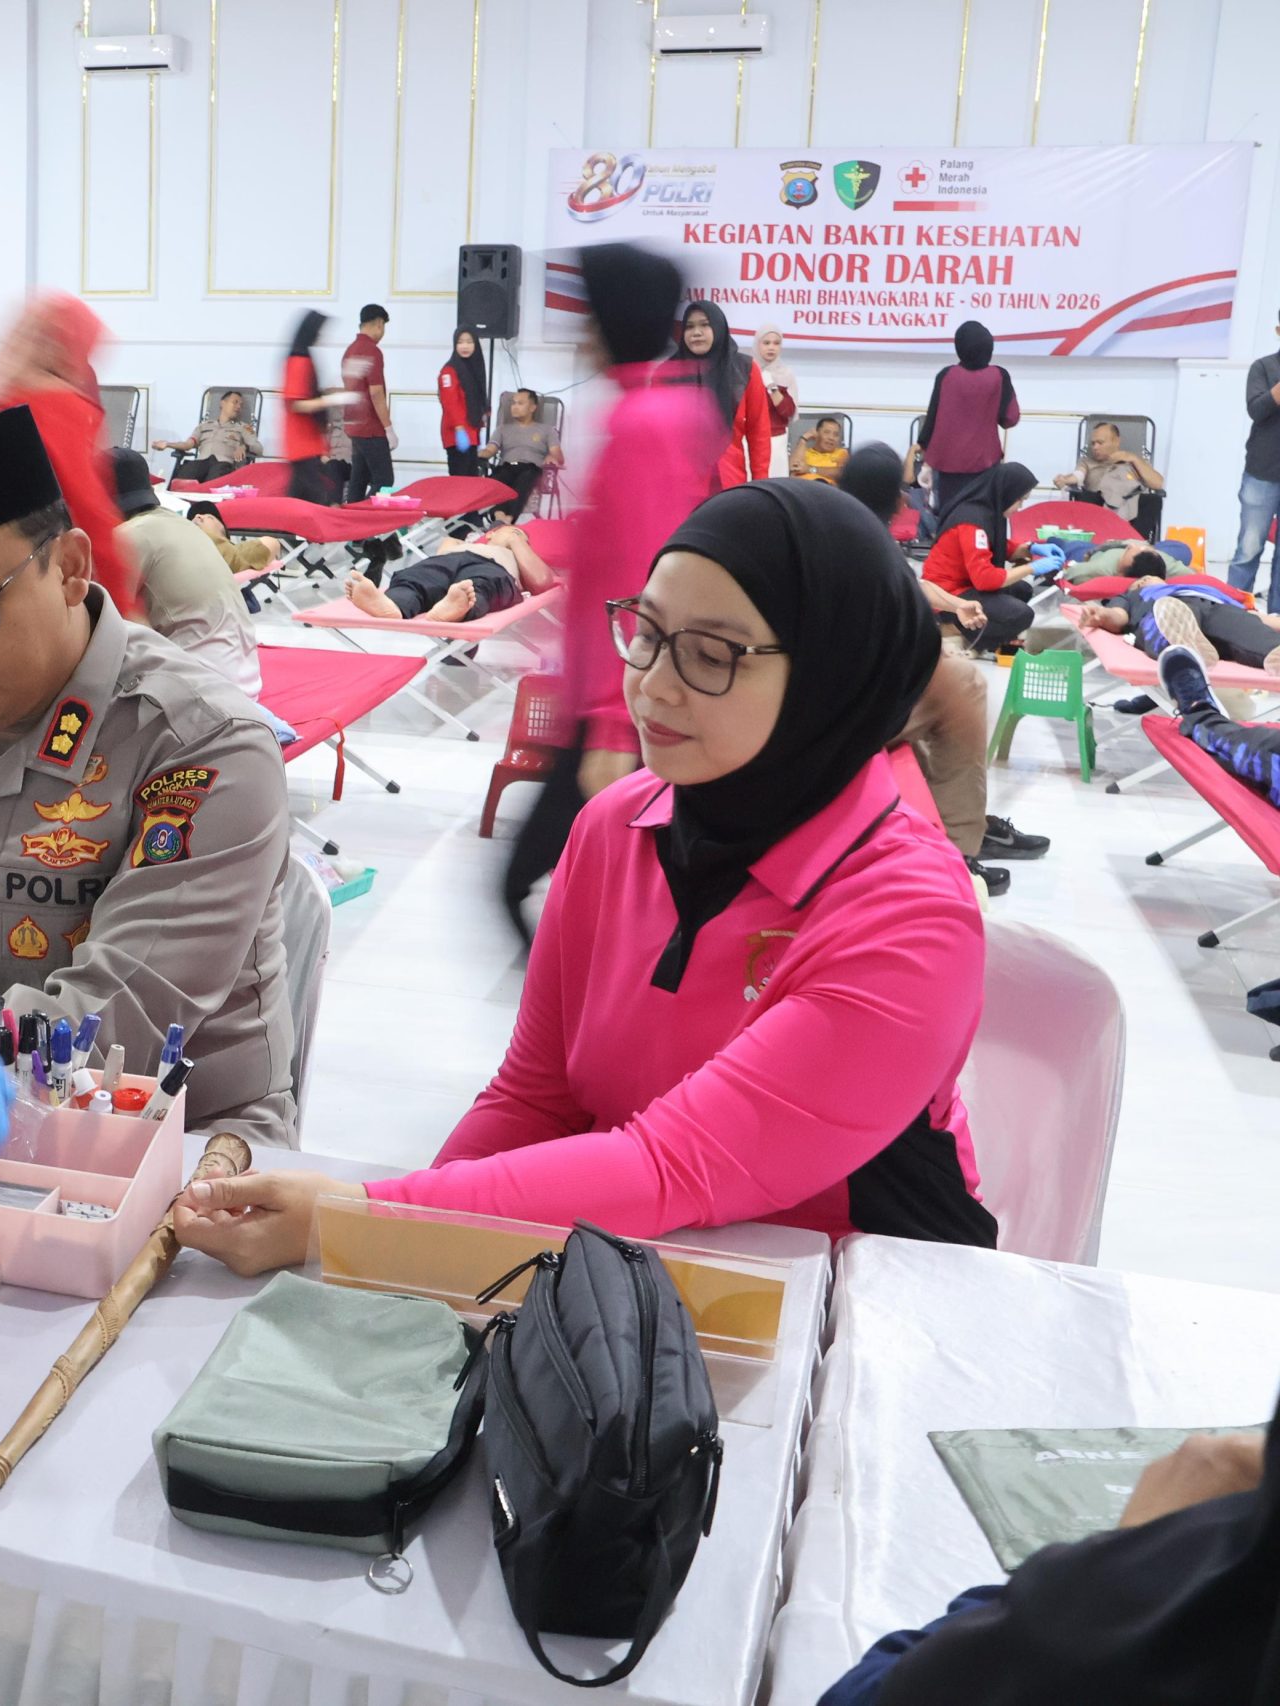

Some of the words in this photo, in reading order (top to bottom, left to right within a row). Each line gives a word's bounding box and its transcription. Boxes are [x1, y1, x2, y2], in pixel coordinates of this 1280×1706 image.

[939, 159, 974, 170] Palang
[570, 151, 646, 206] 80
[938, 172, 970, 183] Merah
[642, 181, 716, 203] POLRI
[937, 185, 988, 195] Indonesia
[683, 223, 813, 246] KEGIATAN
[823, 224, 905, 246] BAKTI
[915, 225, 1081, 247] KESEHATAN
[739, 252, 870, 283] DONOR
[885, 254, 1014, 285] DARAH
[710, 287, 770, 304] RANGKA
[775, 288, 812, 305] HARI
[816, 289, 929, 308] BHAYANGKARA
[934, 291, 956, 308] KE
[970, 291, 993, 309] 80
[998, 292, 1051, 310] TAHUN
[1055, 293, 1101, 310] 2026
[793, 310, 861, 325] POLRES
[868, 311, 948, 328] LANGKAT
[140, 769, 209, 800] POLRES
